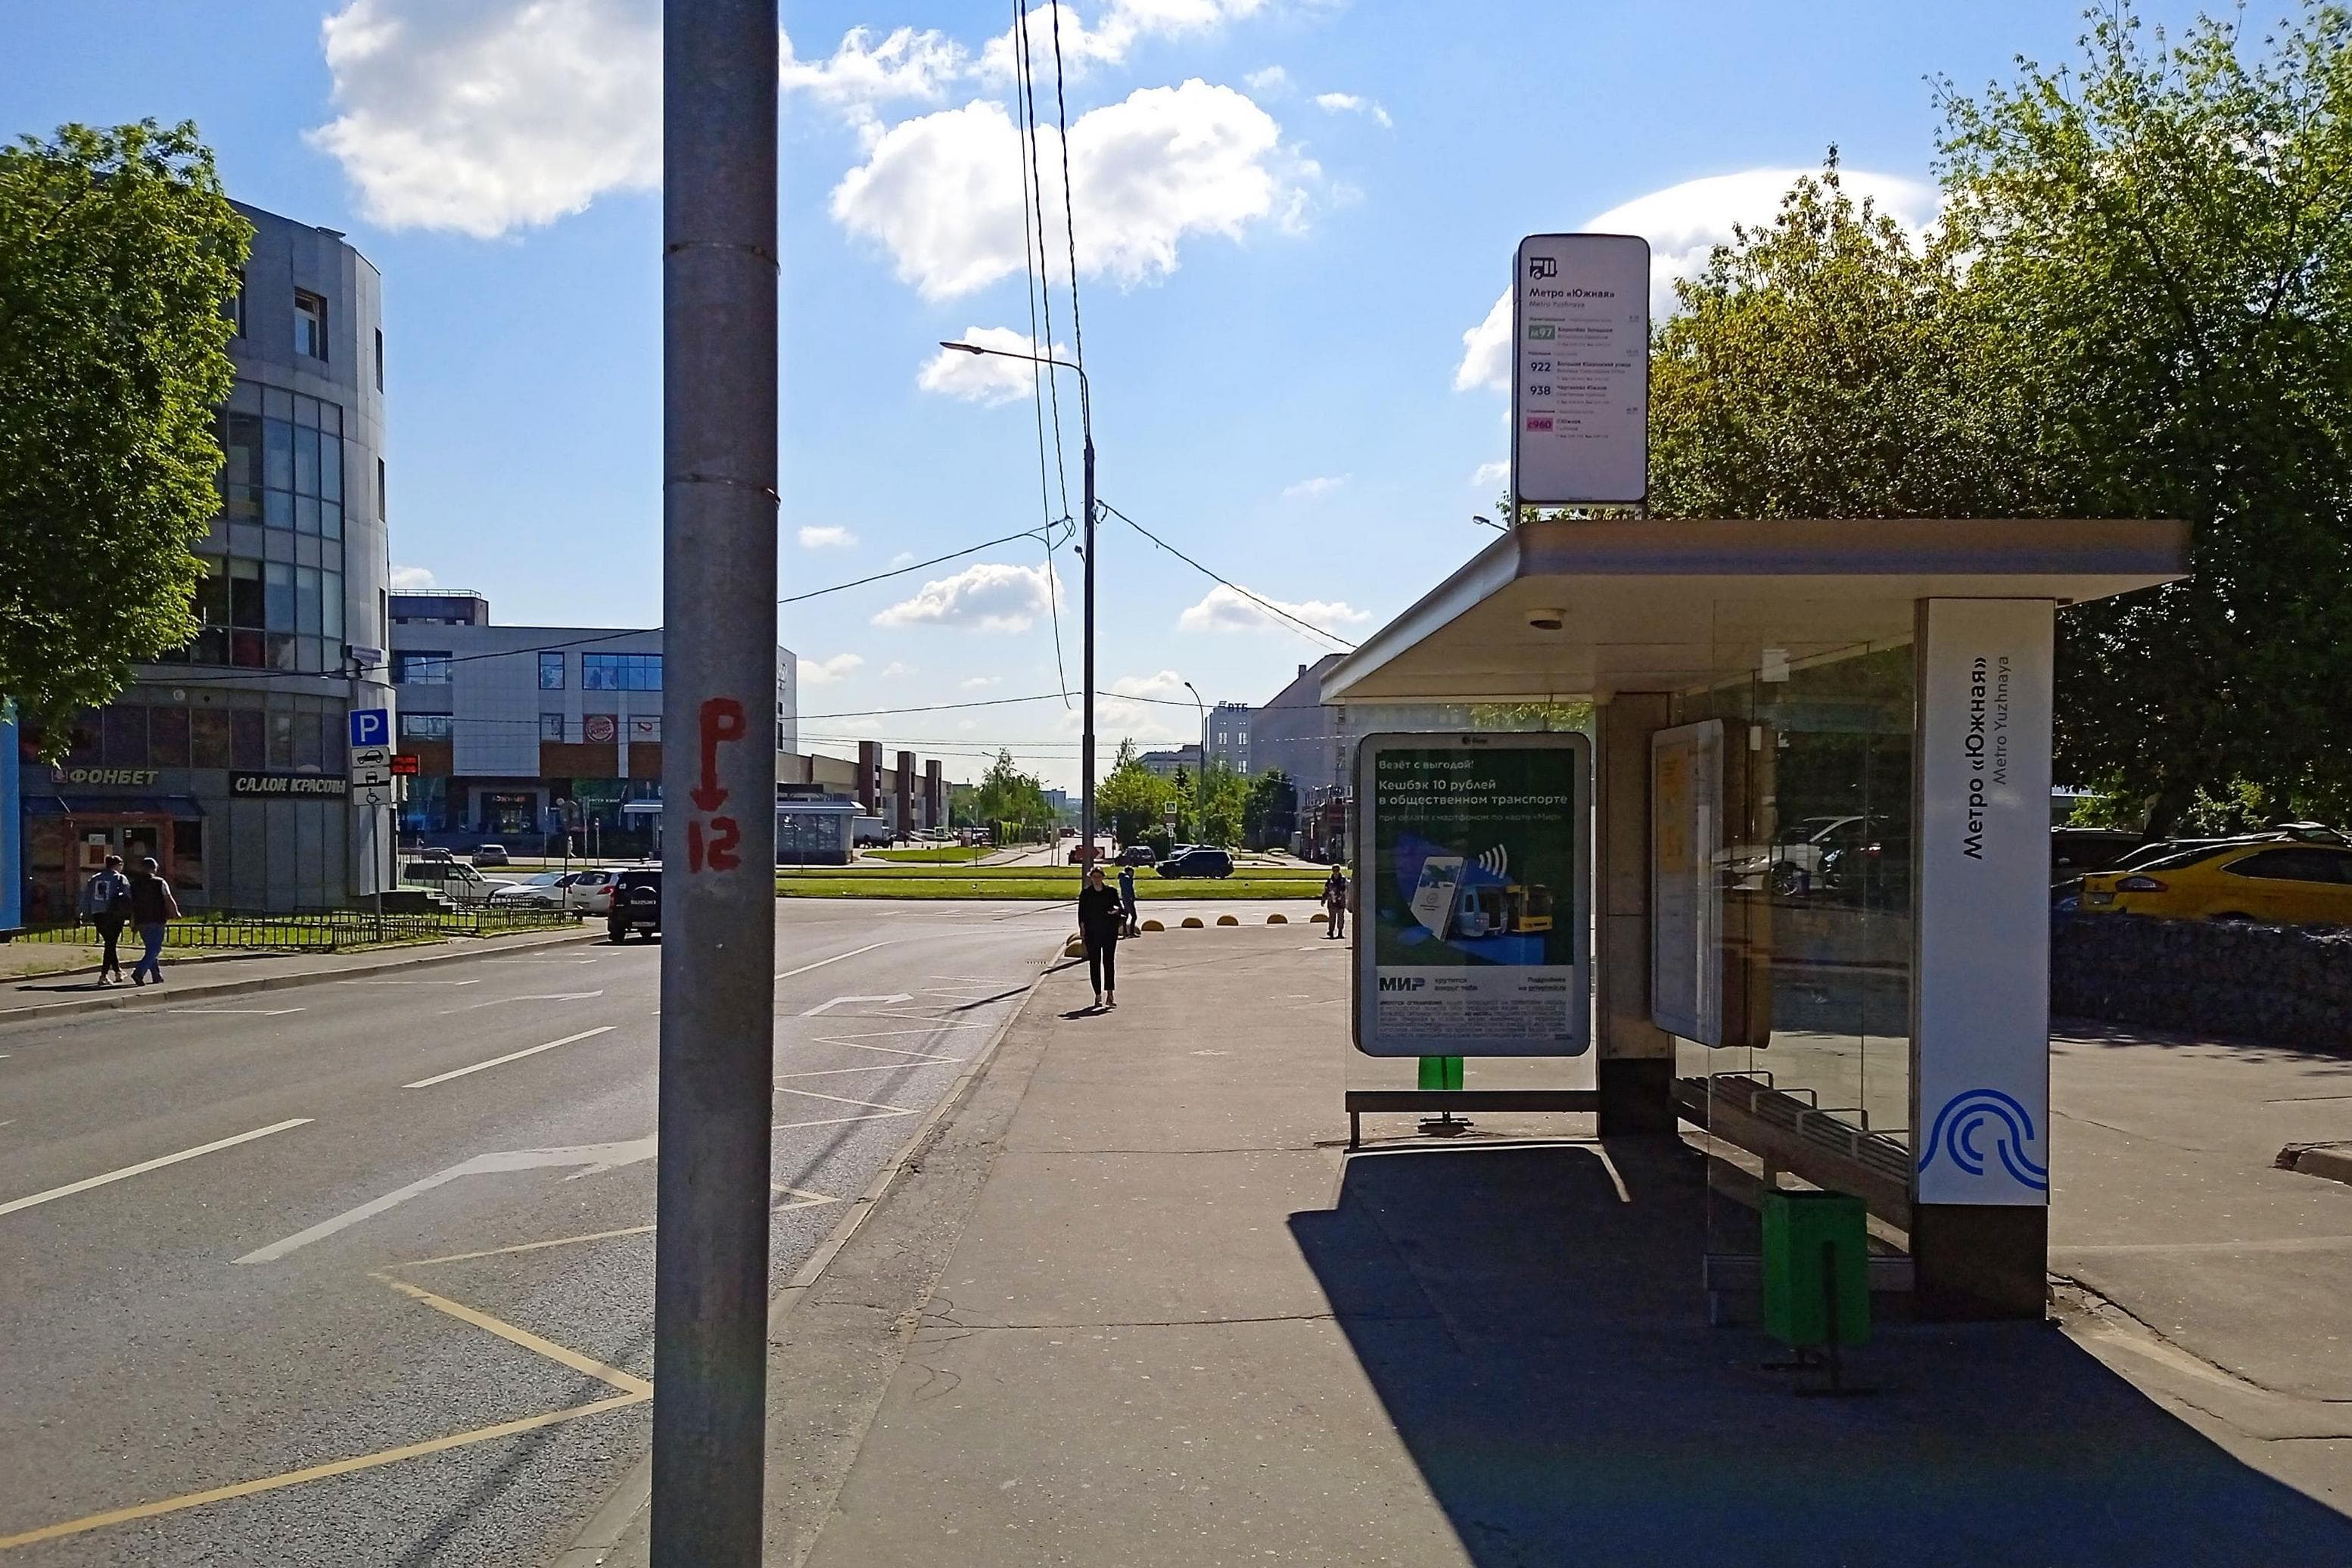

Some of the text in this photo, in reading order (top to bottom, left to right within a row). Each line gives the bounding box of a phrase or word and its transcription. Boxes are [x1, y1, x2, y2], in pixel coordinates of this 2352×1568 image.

[1529, 288, 1616, 299] Метро «Южная»
[1530, 362, 1551, 372] 922
[1529, 385, 1551, 396] 938
[1227, 703, 1248, 713] ВТБ
[1993, 655, 2012, 786] Metro Yuzhnaya
[359, 714, 379, 742] P
[1378, 759, 1475, 770] Везёт с выгодой!
[1963, 656, 1988, 860] Метро «Южная»
[69, 768, 159, 785] ФОНБЕТ
[235, 777, 347, 794] САЛОН КРАСОТЫ
[1378, 779, 1497, 792] Кешбэк 10 рублей
[1379, 795, 1569, 807] в общественном транспорте
[688, 816, 742, 875] 12
[1378, 976, 1426, 991] МИР
